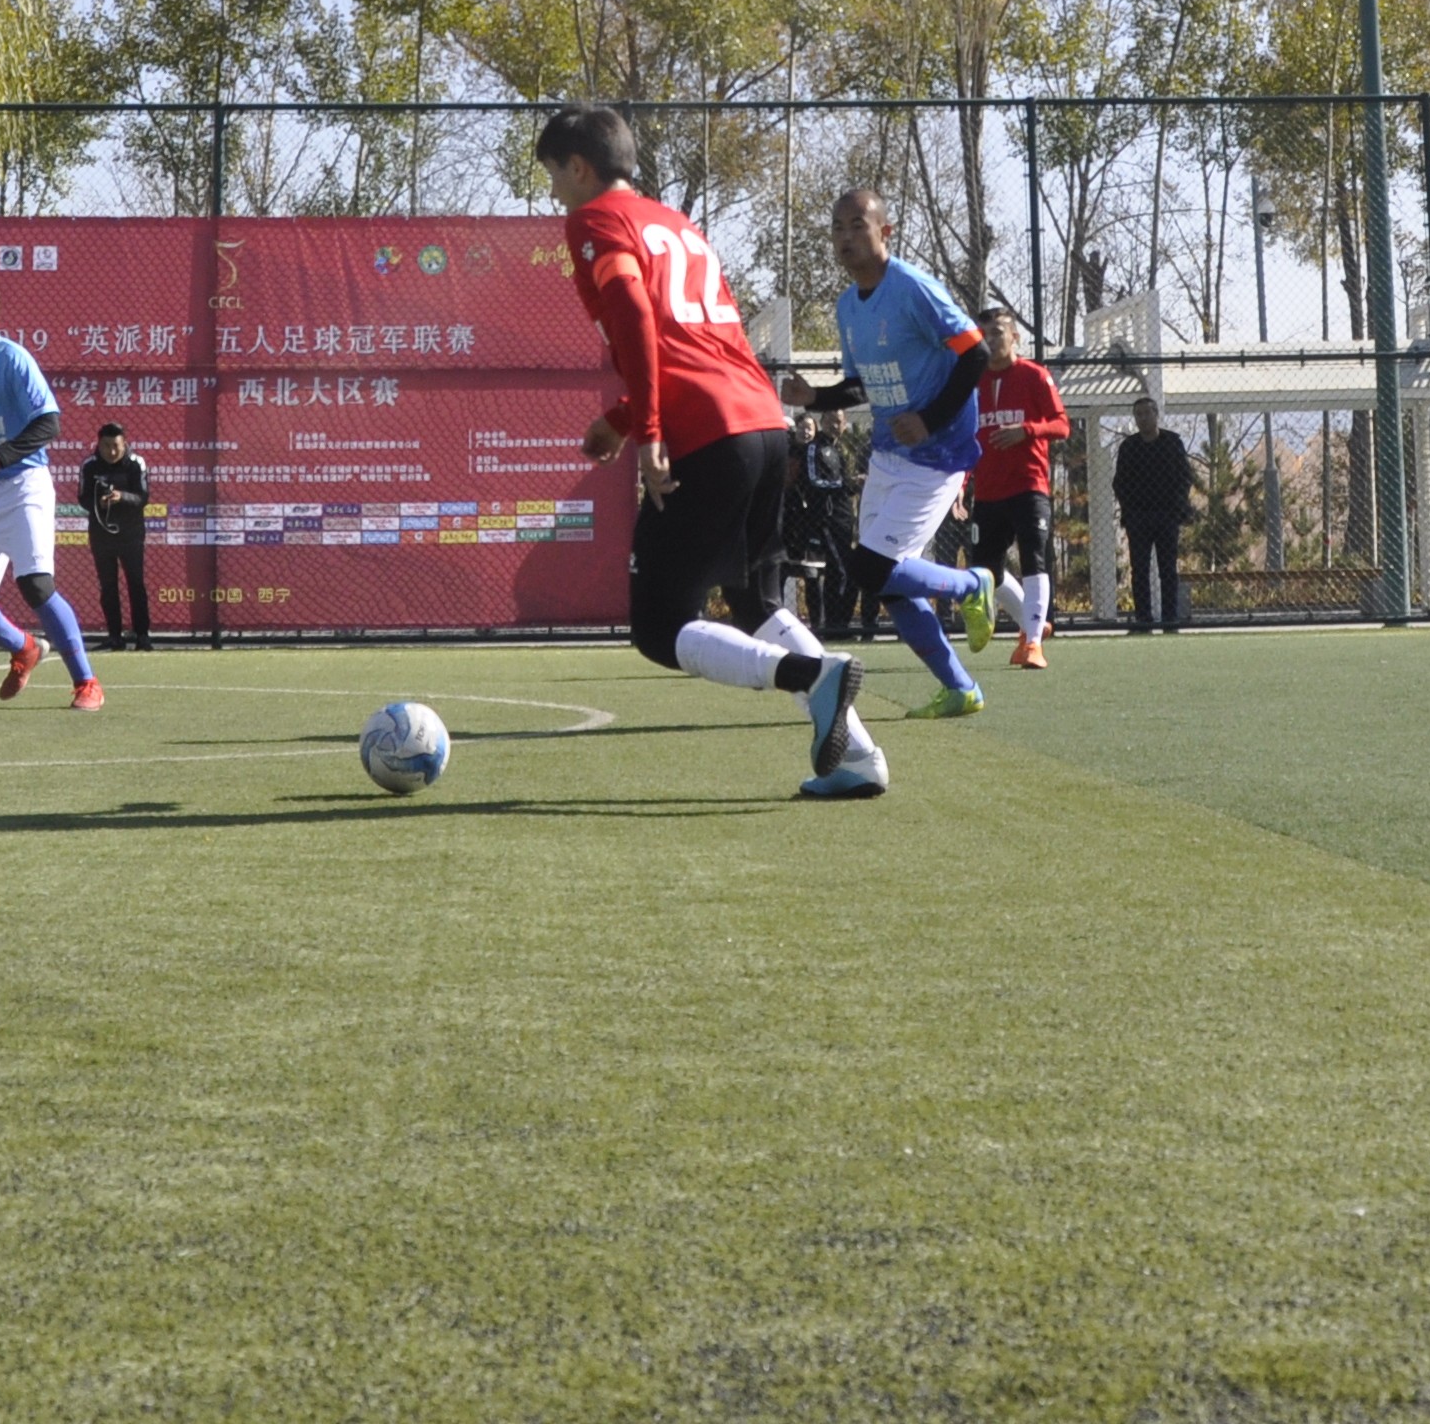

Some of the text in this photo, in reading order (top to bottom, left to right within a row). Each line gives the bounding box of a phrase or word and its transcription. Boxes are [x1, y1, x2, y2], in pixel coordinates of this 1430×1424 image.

[642, 224, 740, 324] 22
[215, 324, 476, 356] 五人足球冠军联赛
[51, 376, 399, 408] “宏盛监理” 西北大区赛
